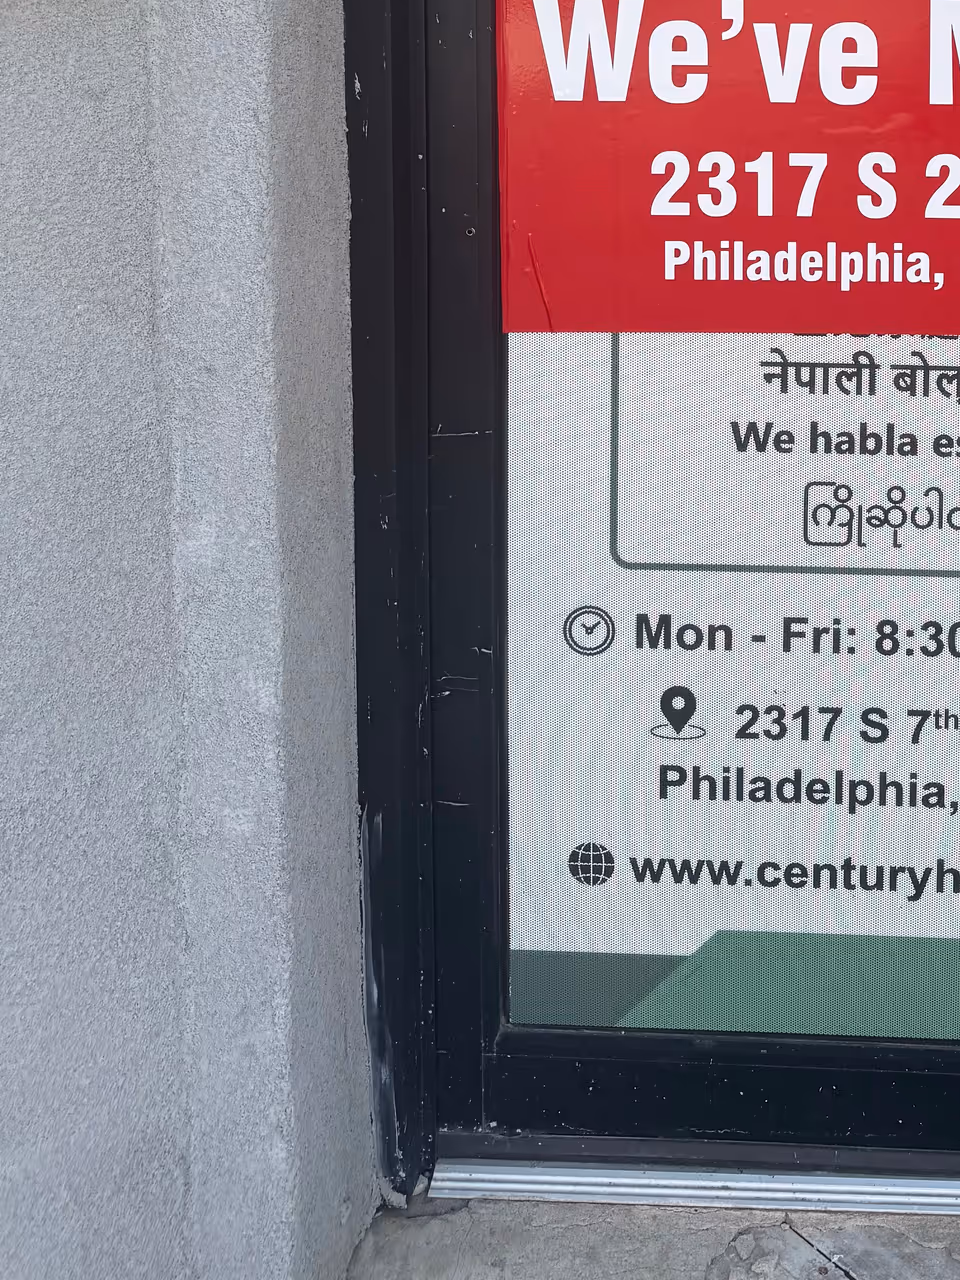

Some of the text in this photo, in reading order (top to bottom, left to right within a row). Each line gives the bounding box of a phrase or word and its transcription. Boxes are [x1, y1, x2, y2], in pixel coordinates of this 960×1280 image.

[651, 151, 827, 216] 2317
[857, 152, 896, 218] S
[665, 241, 944, 291] Philadelphia,
[760, 348, 880, 395] नेपाली
[731, 422, 795, 453] We
[810, 421, 918, 456] habla
[636, 614, 732, 651] Mon
[782, 617, 855, 654] Fri:
[736, 704, 842, 741] 2317
[860, 707, 889, 743] S
[659, 764, 958, 814] Philadelphia,
